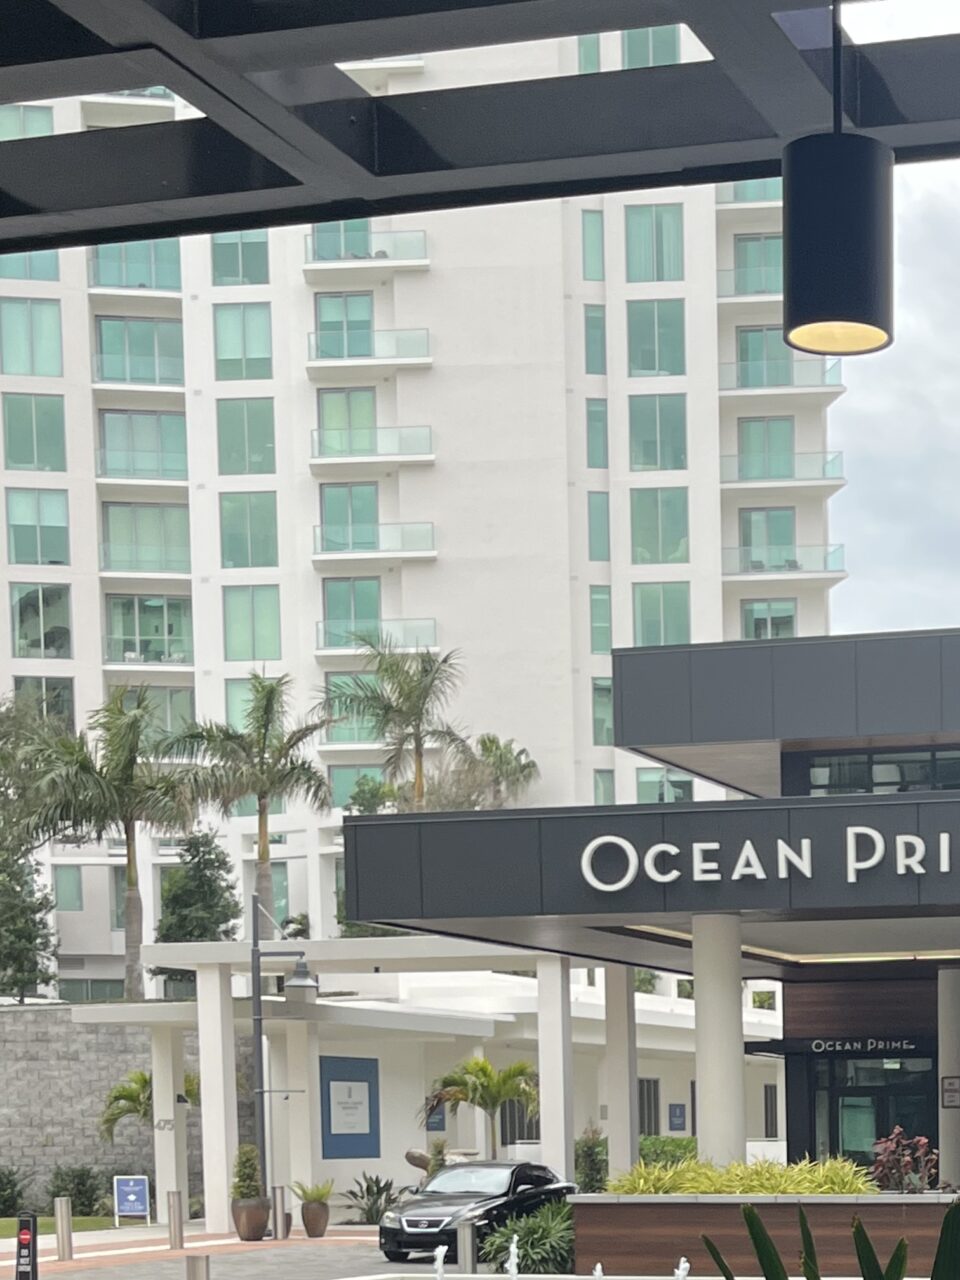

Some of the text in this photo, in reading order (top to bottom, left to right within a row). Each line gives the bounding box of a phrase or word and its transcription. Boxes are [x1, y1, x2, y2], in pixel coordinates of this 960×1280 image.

[580, 835, 813, 892] OCEAN
[811, 1038, 910, 1052] OCEAN PRIME
